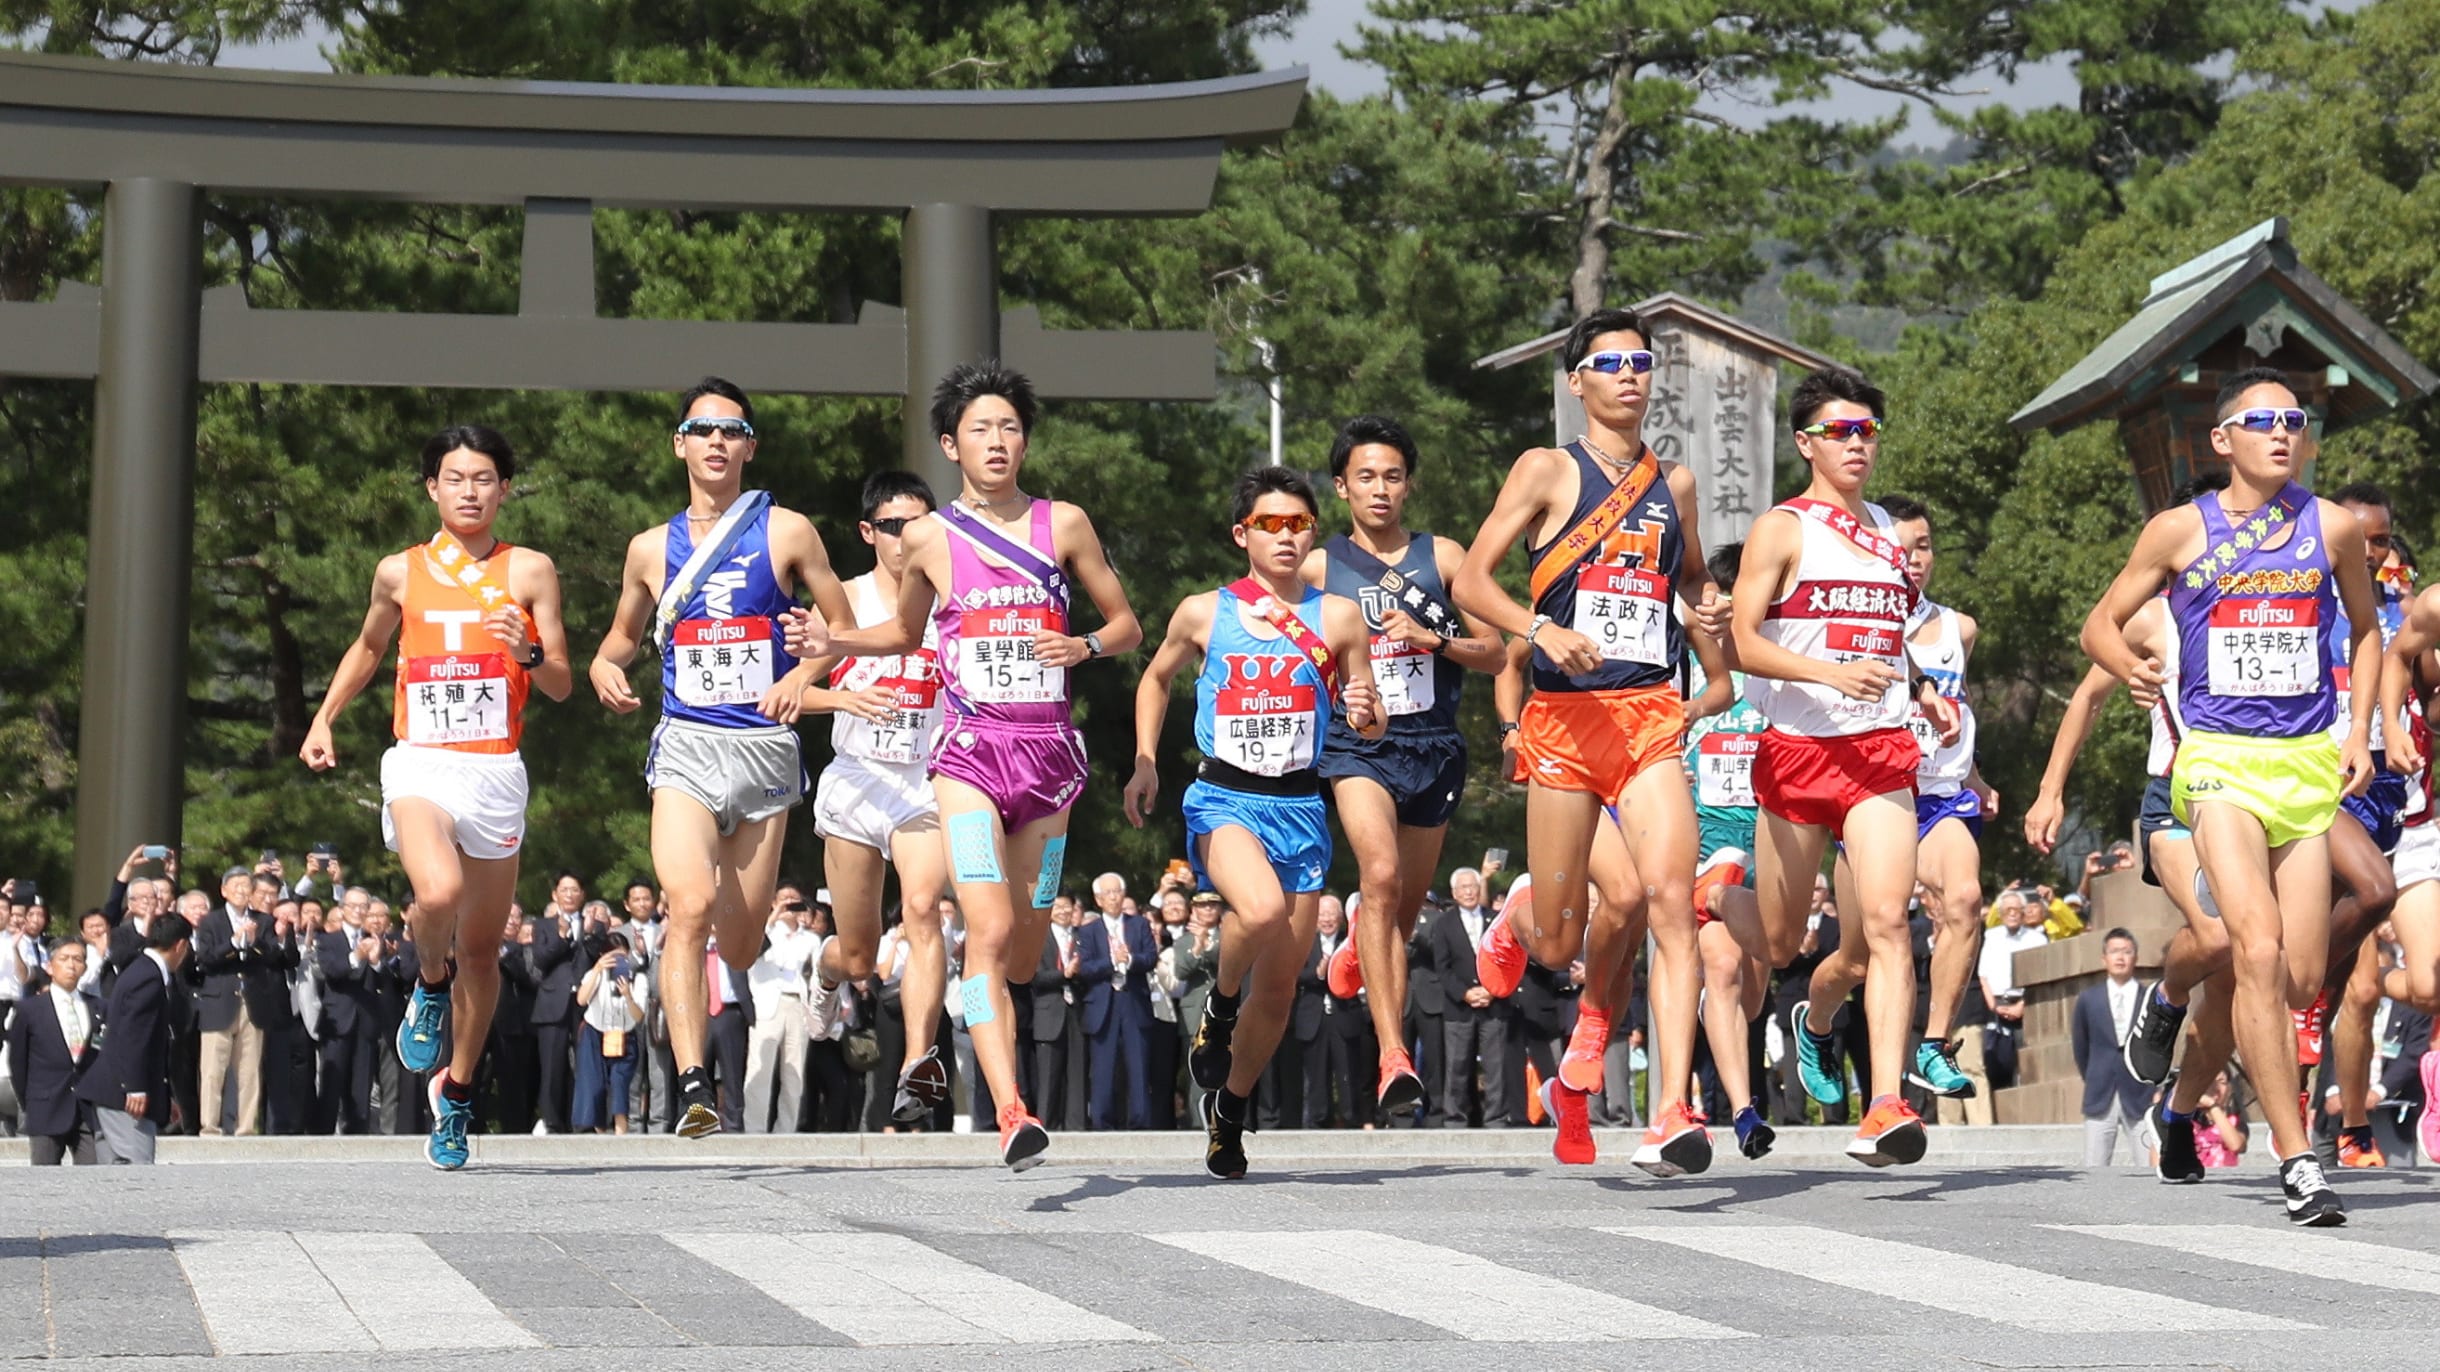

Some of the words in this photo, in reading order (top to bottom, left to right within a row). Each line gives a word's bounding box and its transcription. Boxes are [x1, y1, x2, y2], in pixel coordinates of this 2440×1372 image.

[1711, 365, 1753, 518] 出雲大社
[1608, 569, 1653, 594] FUJITSU
[2217, 567, 2322, 595] 中央学院大学
[989, 610, 1042, 635] FUJITSU
[1590, 595, 1660, 626] 法政大
[2239, 599, 2294, 627] FUJITSU
[424, 610, 480, 651] T
[697, 620, 746, 644] FUJITSU
[1851, 628, 1894, 652] FUJITSU
[2224, 631, 2309, 654] 中央学院大
[429, 656, 480, 680] FUJITSU
[686, 643, 760, 669] 東海大
[984, 664, 1045, 688] 15-1
[2233, 657, 2298, 680] 13-1
[701, 670, 744, 692] 8-1
[420, 682, 495, 706] 拓殖大
[1241, 689, 1293, 714] FUJITSU
[430, 707, 484, 729] 11-1
[1230, 715, 1306, 738] 広島経済大
[873, 729, 919, 752] 17-1
[1238, 741, 1295, 763] 19-1
